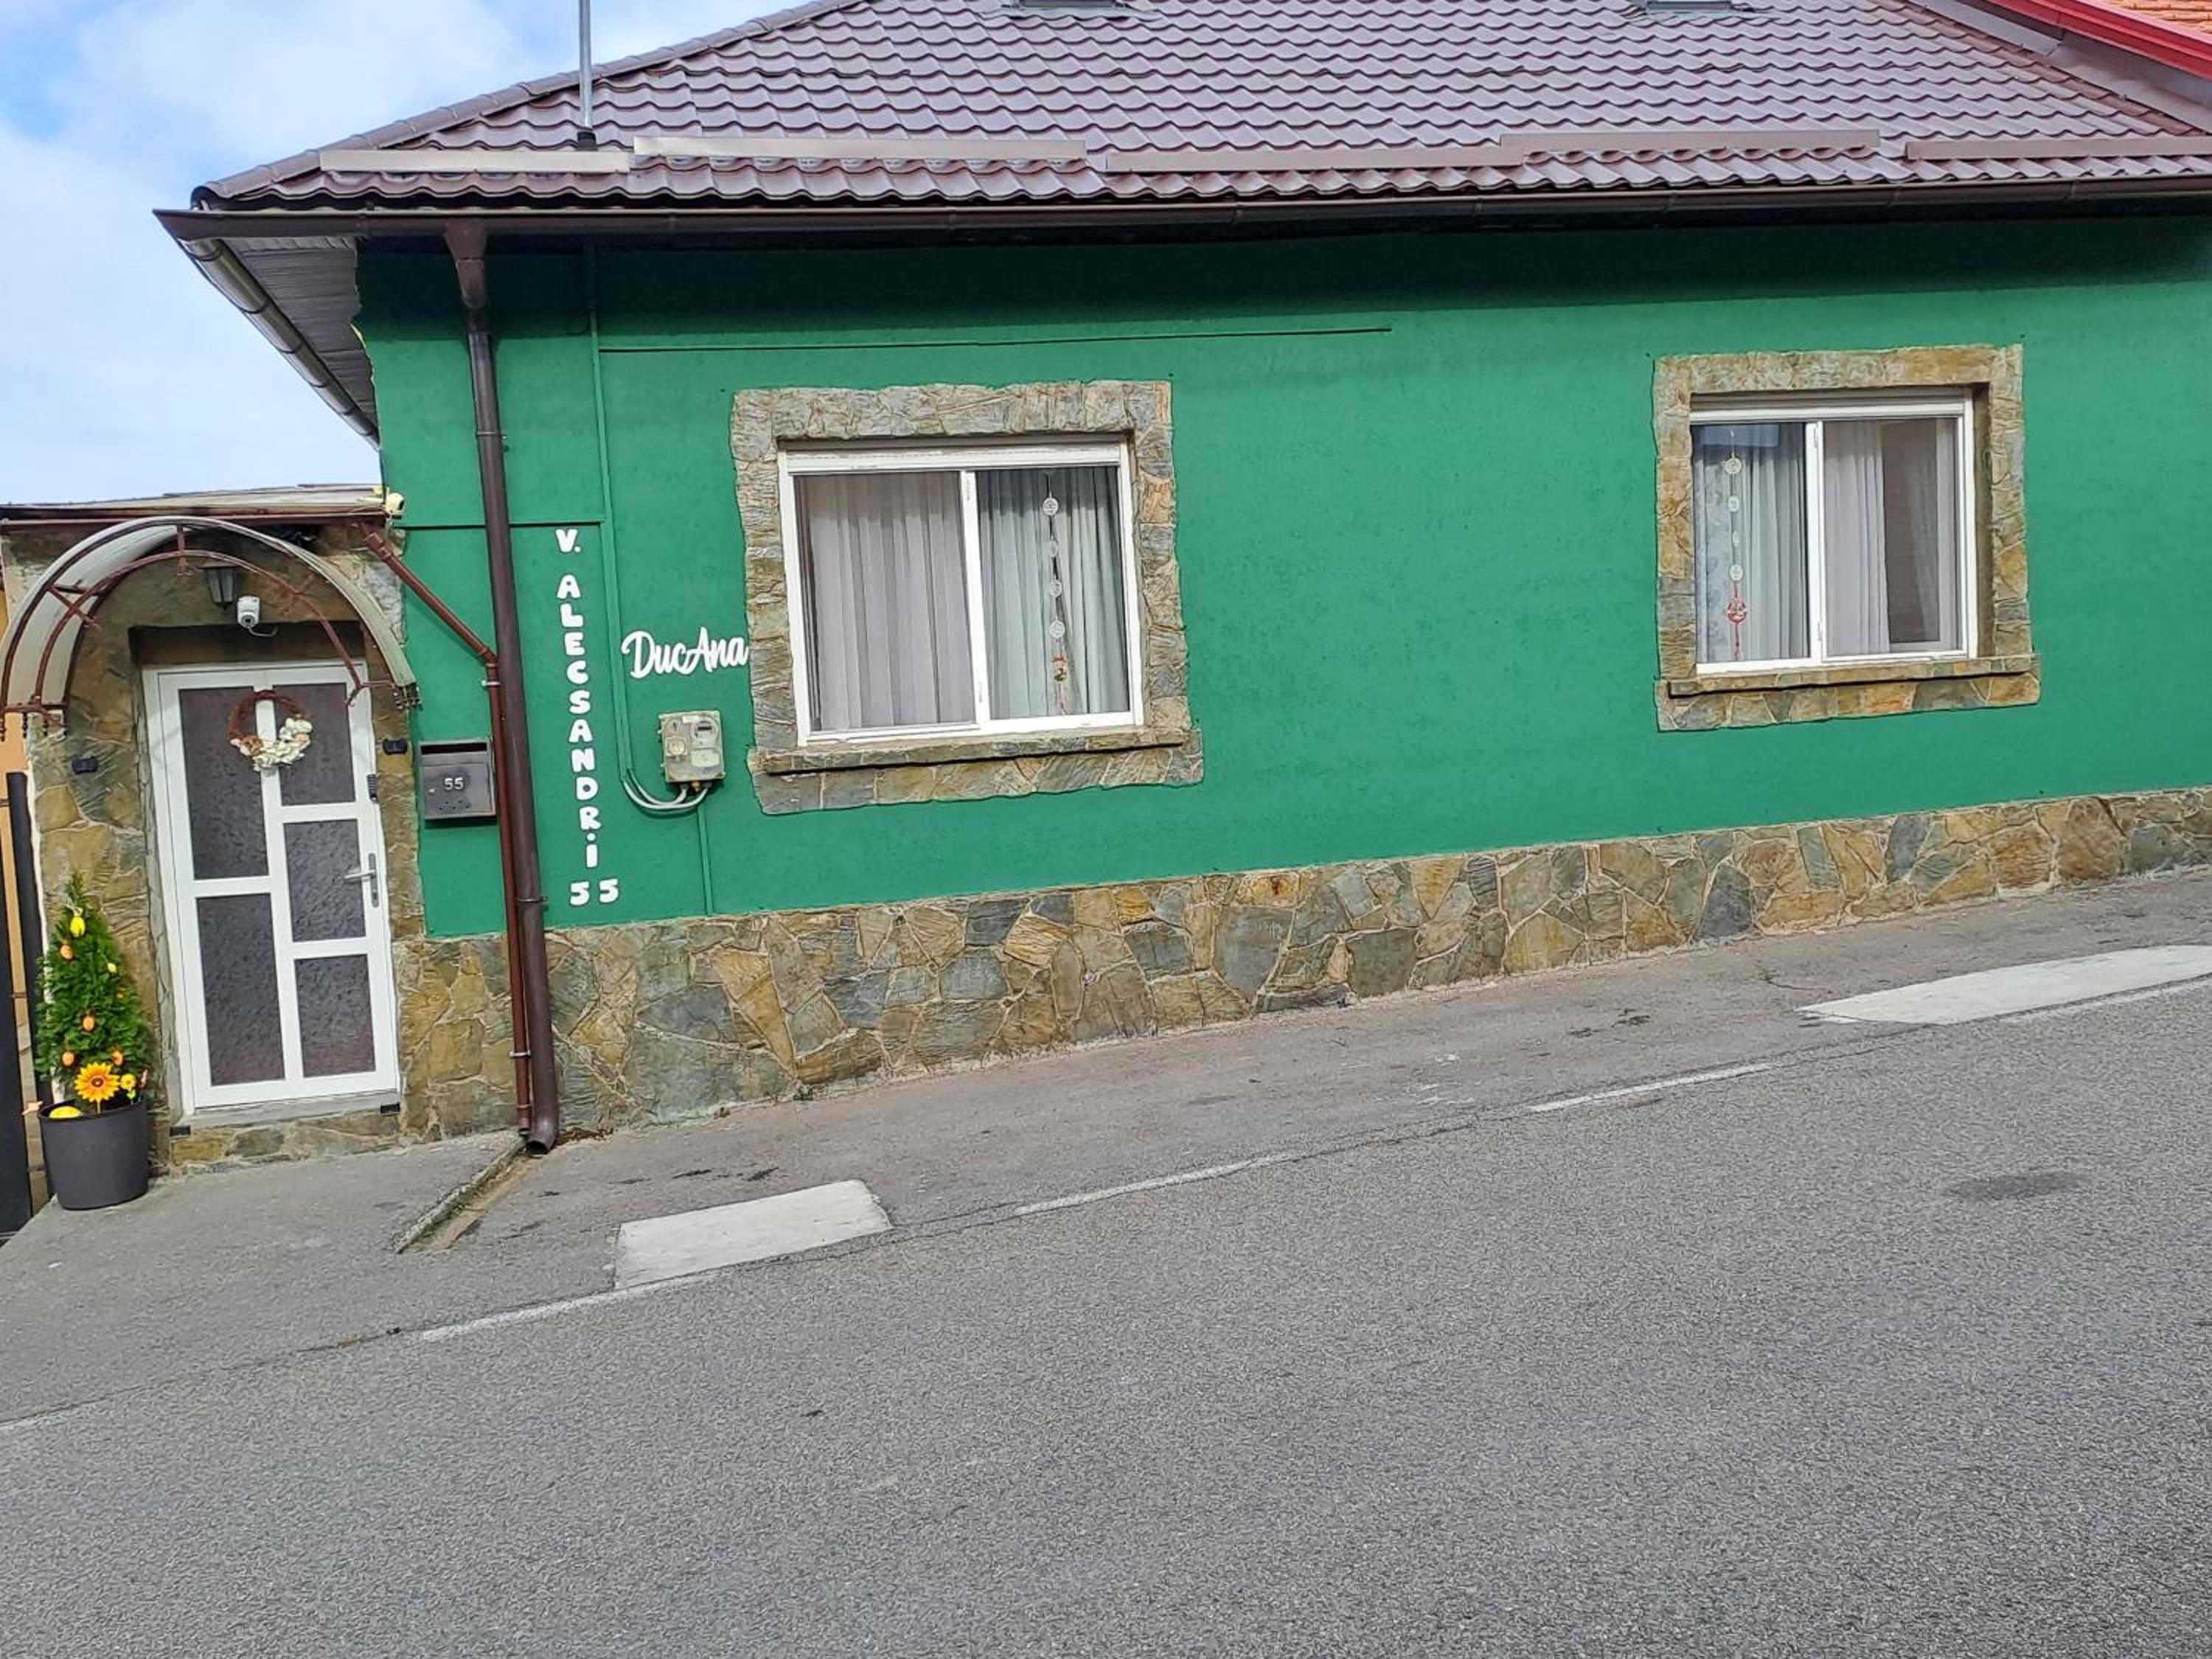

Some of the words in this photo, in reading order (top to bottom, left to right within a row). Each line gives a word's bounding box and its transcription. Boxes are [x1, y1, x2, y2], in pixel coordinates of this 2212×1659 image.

[555, 529, 581, 553] V.
[621, 626, 750, 679] DucAna
[444, 776, 465, 791] 55
[569, 877, 619, 906] 55
